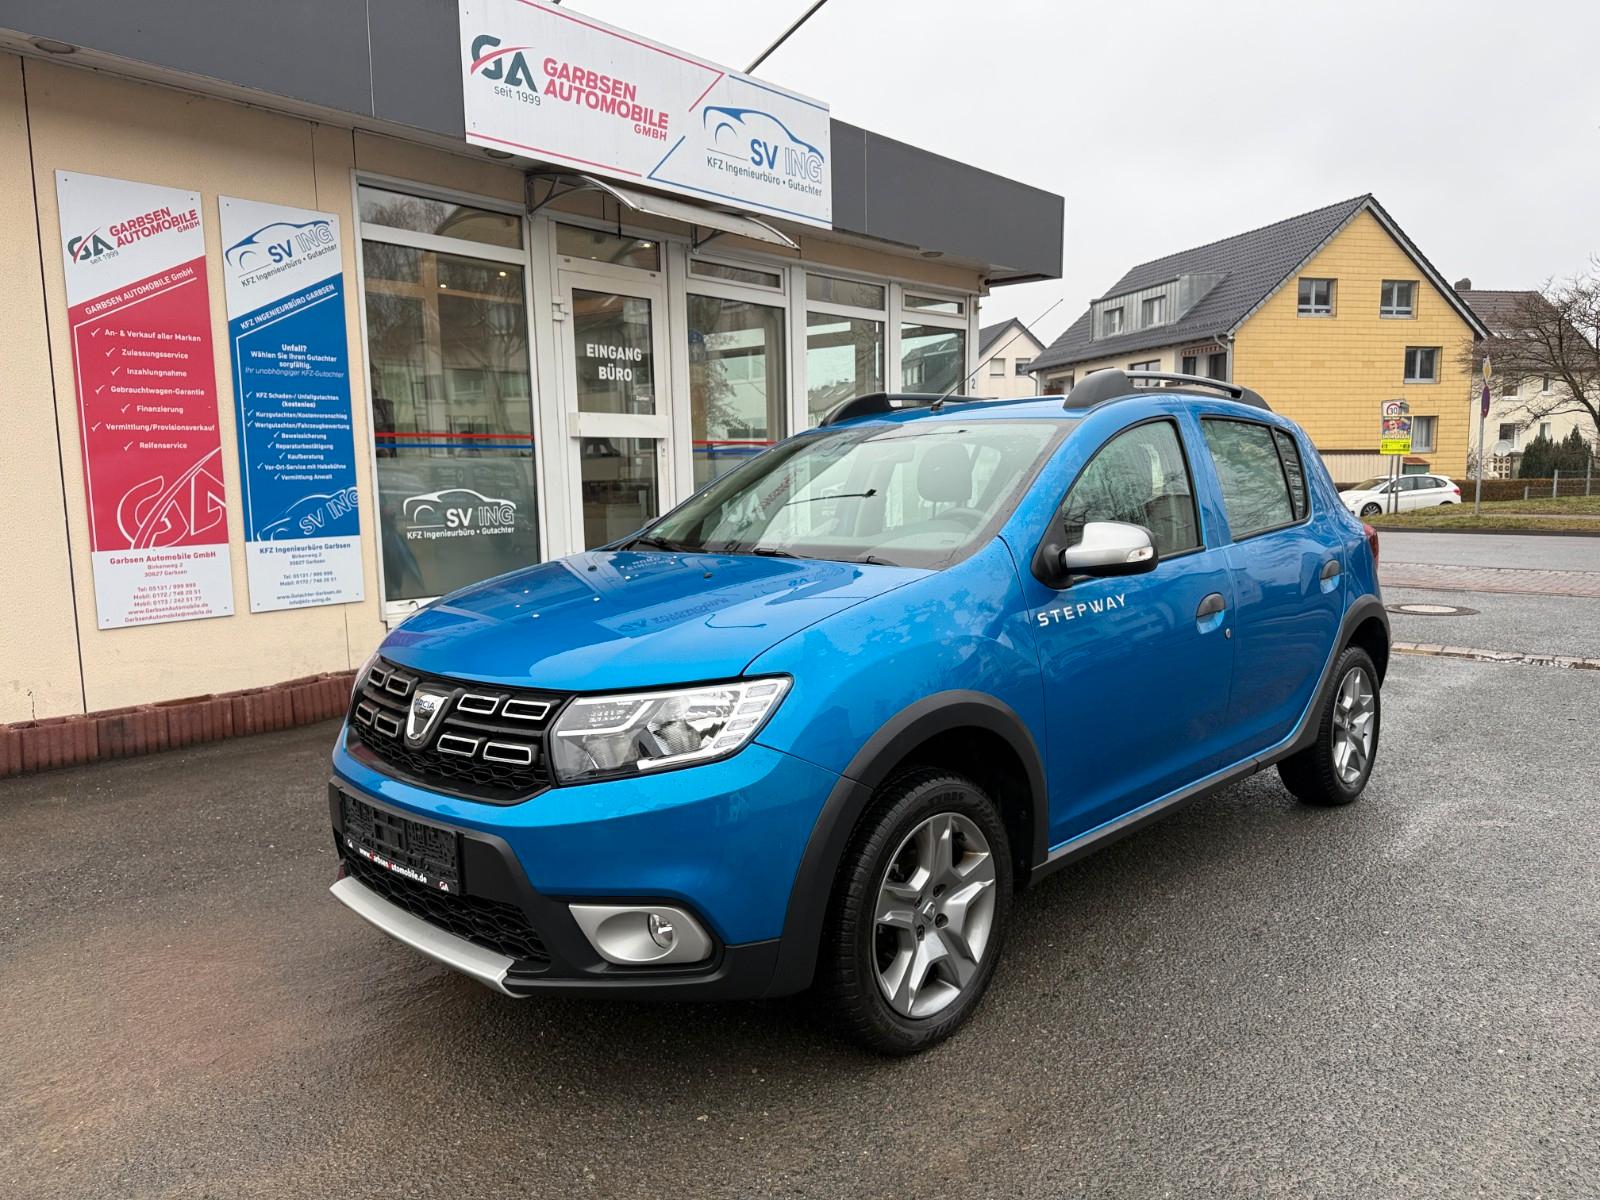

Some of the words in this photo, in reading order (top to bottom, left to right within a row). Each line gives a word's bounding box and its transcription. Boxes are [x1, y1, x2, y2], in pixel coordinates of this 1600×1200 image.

[543, 58, 636, 102] GARBSEN
[494, 85, 512, 99] seit
[516, 90, 541, 106] 1999
[544, 79, 668, 130] AUTOMOBILE
[634, 124, 667, 141] GMBH
[751, 139, 778, 169] SV
[785, 147, 822, 183] ING
[706, 156, 723, 170] KFZ
[725, 162, 780, 186] Ingenieurbüro
[788, 176, 822, 197] Gutachter
[109, 207, 171, 237] GARBSEN
[117, 209, 198, 247] AUTOMOBILE
[177, 220, 200, 233] GMBH
[268, 240, 292, 263] SV
[295, 224, 335, 252] ING
[90, 256, 102, 265] seit
[103, 250, 119, 262] 1999
[241, 276, 256, 287] KFZ
[256, 256, 302, 281] Ingenieurbüro
[307, 243, 337, 260] Gutachter
[85, 295, 122, 315] GARBSEN
[123, 276, 170, 300] AUTOMOBILE
[172, 268, 194, 281] GmbH
[240, 318, 255, 329] KFZ
[255, 296, 305, 324] INGENIEURBÜRO
[306, 284, 335, 302] GARBSEN
[105, 329, 118, 337] An-
[120, 329, 125, 337] &
[127, 330, 155, 339] Verkauf
[157, 332, 172, 340] aller
[175, 333, 201, 342] Marken
[122, 349, 189, 359] Zulassungsservice
[251, 351, 276, 359] Wählen
[307, 354, 337, 362] Gutachter
[282, 344, 307, 352] Unfall?
[586, 343, 642, 361] EINGANG
[127, 368, 187, 377] Inzahlungnahme
[598, 364, 632, 381] BÜRO
[111, 386, 205, 396] Gebrauchtwagen-Garantie
[137, 405, 184, 414] Finanzierung
[106, 424, 215, 432] Vermittlung/Provisionsverkauf
[299, 508, 324, 535] SV
[446, 507, 472, 528] SV
[478, 506, 514, 526] ING
[407, 530, 422, 540] KFZ
[424, 527, 475, 540] Ingenieurbüro
[482, 526, 514, 535] Gutachter
[110, 556, 144, 565] Garbsen
[146, 553, 191, 562] Automobile
[1037, 593, 1127, 627] STEPWAY
